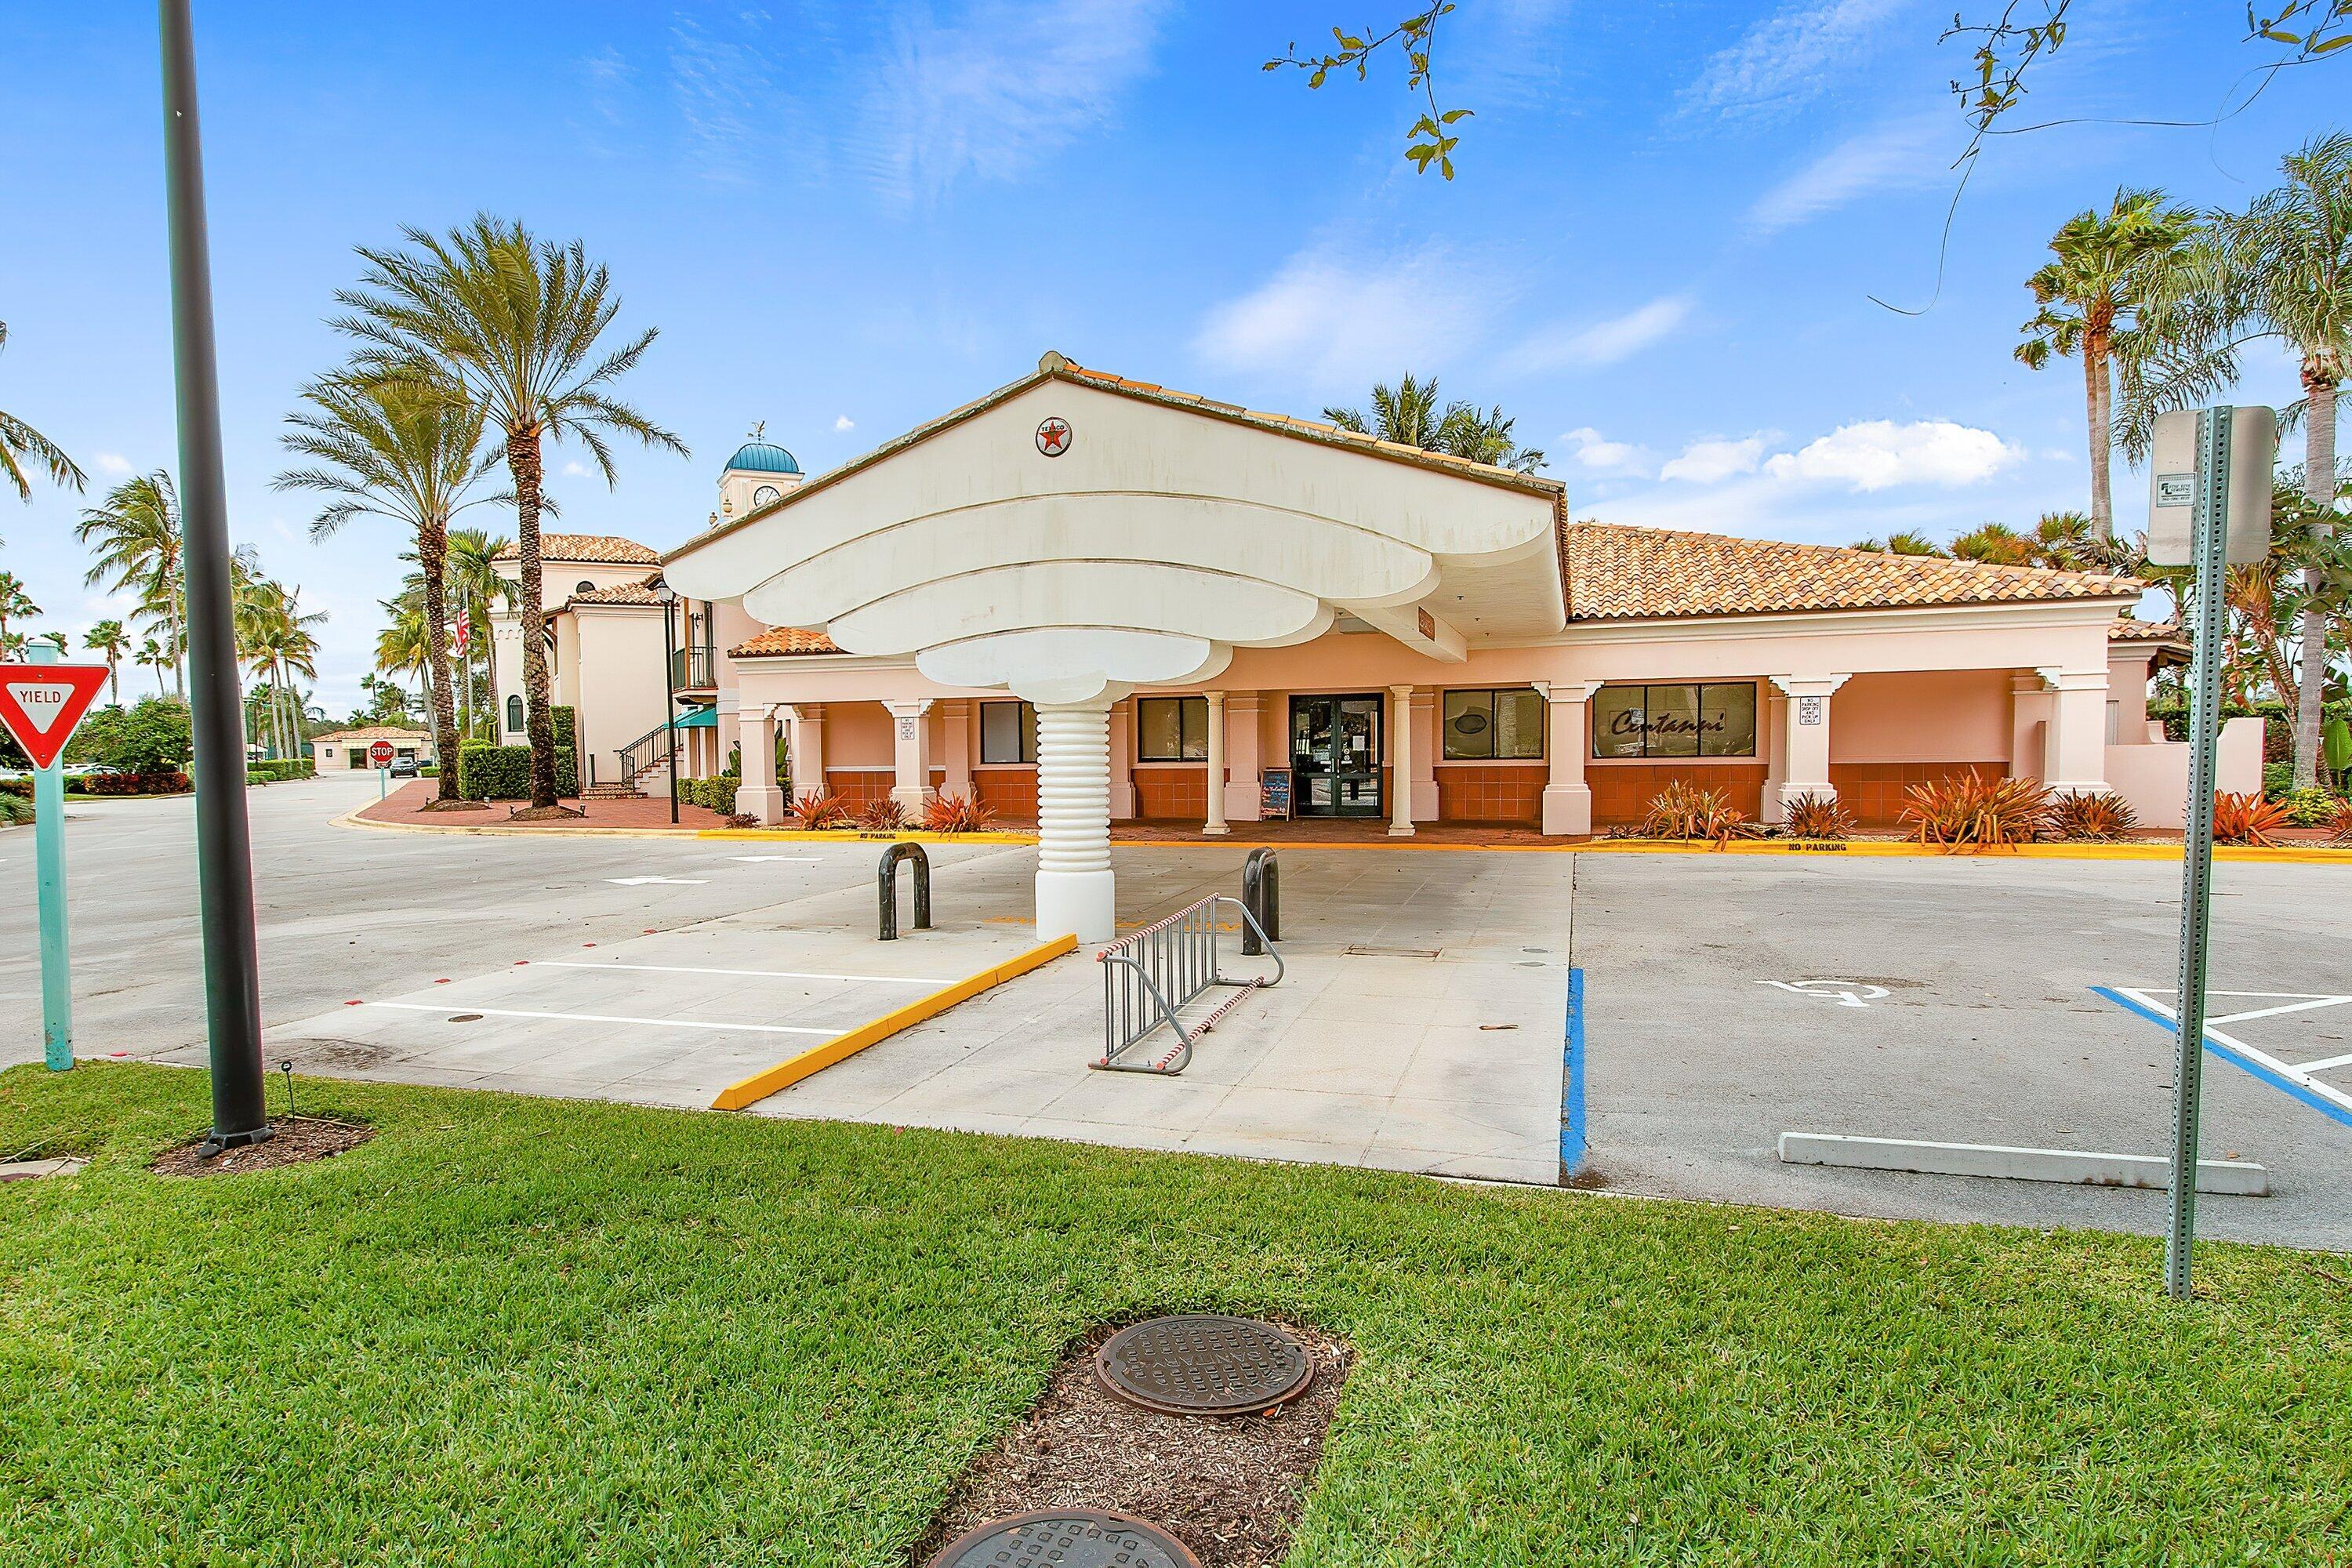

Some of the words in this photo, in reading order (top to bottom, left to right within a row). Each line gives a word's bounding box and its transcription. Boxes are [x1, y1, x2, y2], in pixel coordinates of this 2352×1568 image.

[20, 691, 60, 702] YIELD
[372, 747, 392, 756] STOP
[1152, 1351, 1262, 1367] SANITARY
